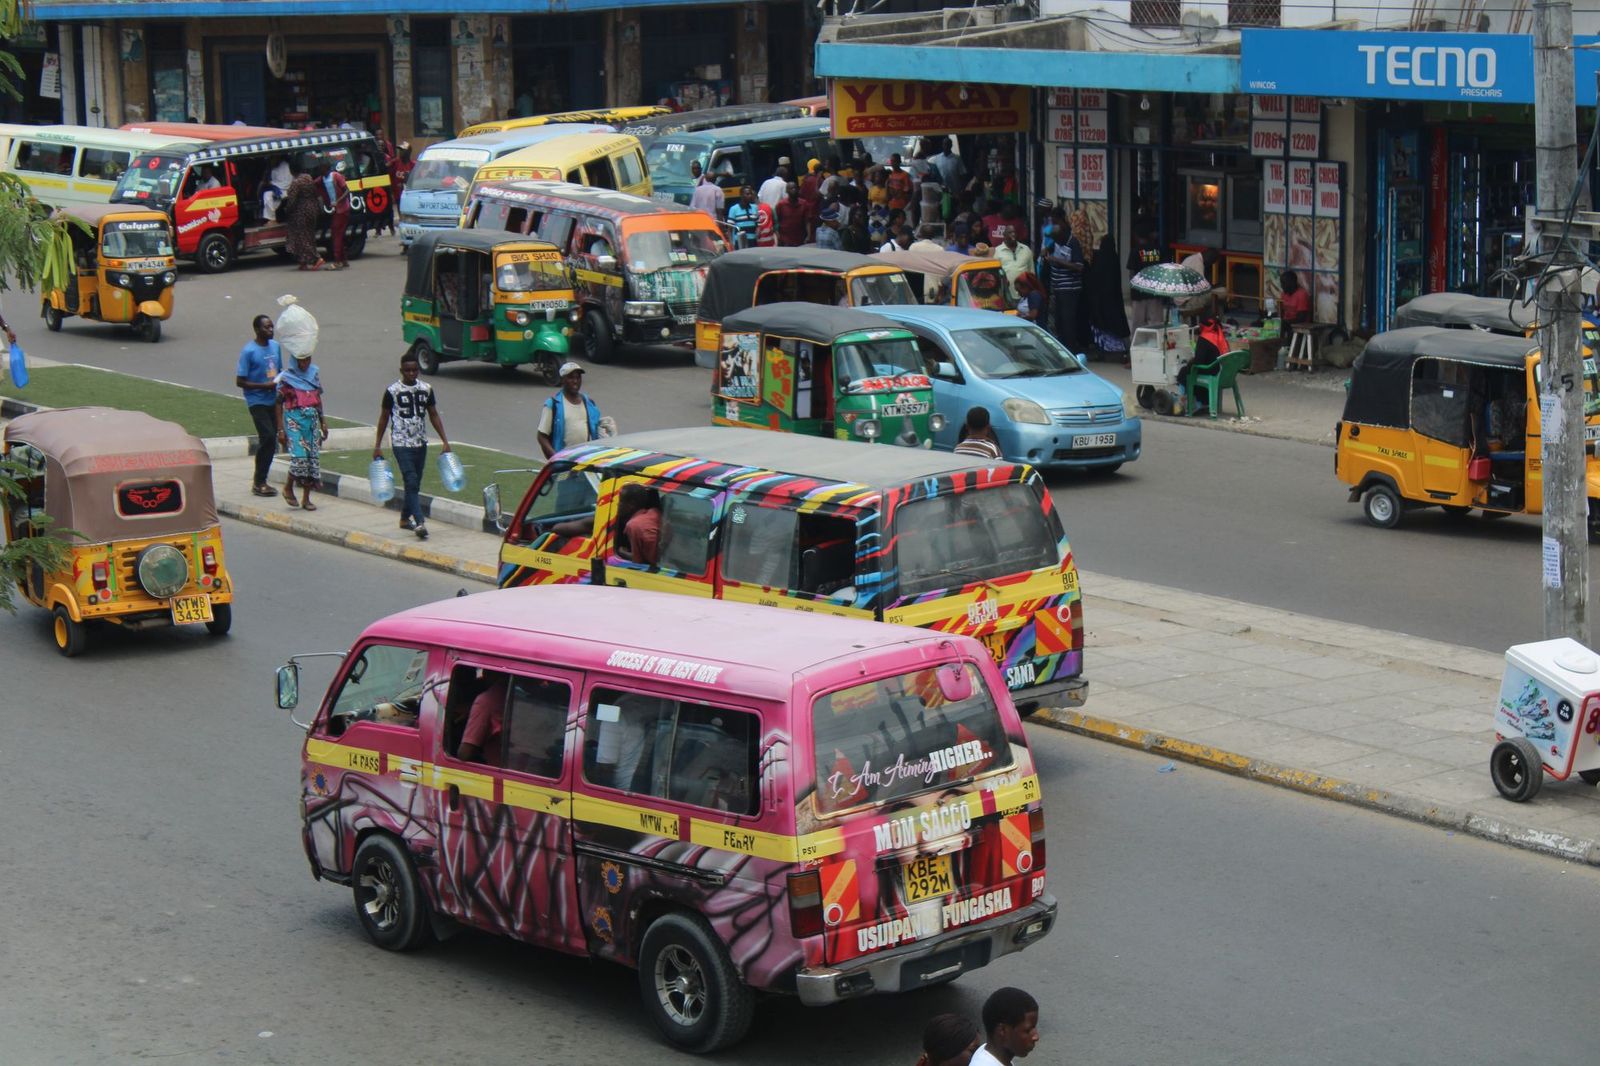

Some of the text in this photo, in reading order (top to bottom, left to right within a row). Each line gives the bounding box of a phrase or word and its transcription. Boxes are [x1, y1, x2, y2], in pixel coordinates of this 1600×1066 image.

[1358, 45, 1496, 88] TECNO
[843, 82, 1018, 112] YUKAY
[1250, 80, 1276, 90] WINCOS
[511, 254, 530, 262] BIG
[1561, 373, 1574, 392] 5
[1074, 436, 1089, 447] KBU
[178, 608, 210, 622] 343L
[1006, 663, 1036, 687] SANA
[360, 755, 379, 773] PASS
[850, 760, 881, 795] Am
[883, 753, 936, 789] Aiming
[921, 800, 972, 843] SACCO
[802, 846, 817, 856] PSV
[907, 857, 937, 881] KBE
[910, 871, 952, 900] 292M
[943, 886, 1013, 930] FUNGASHA
